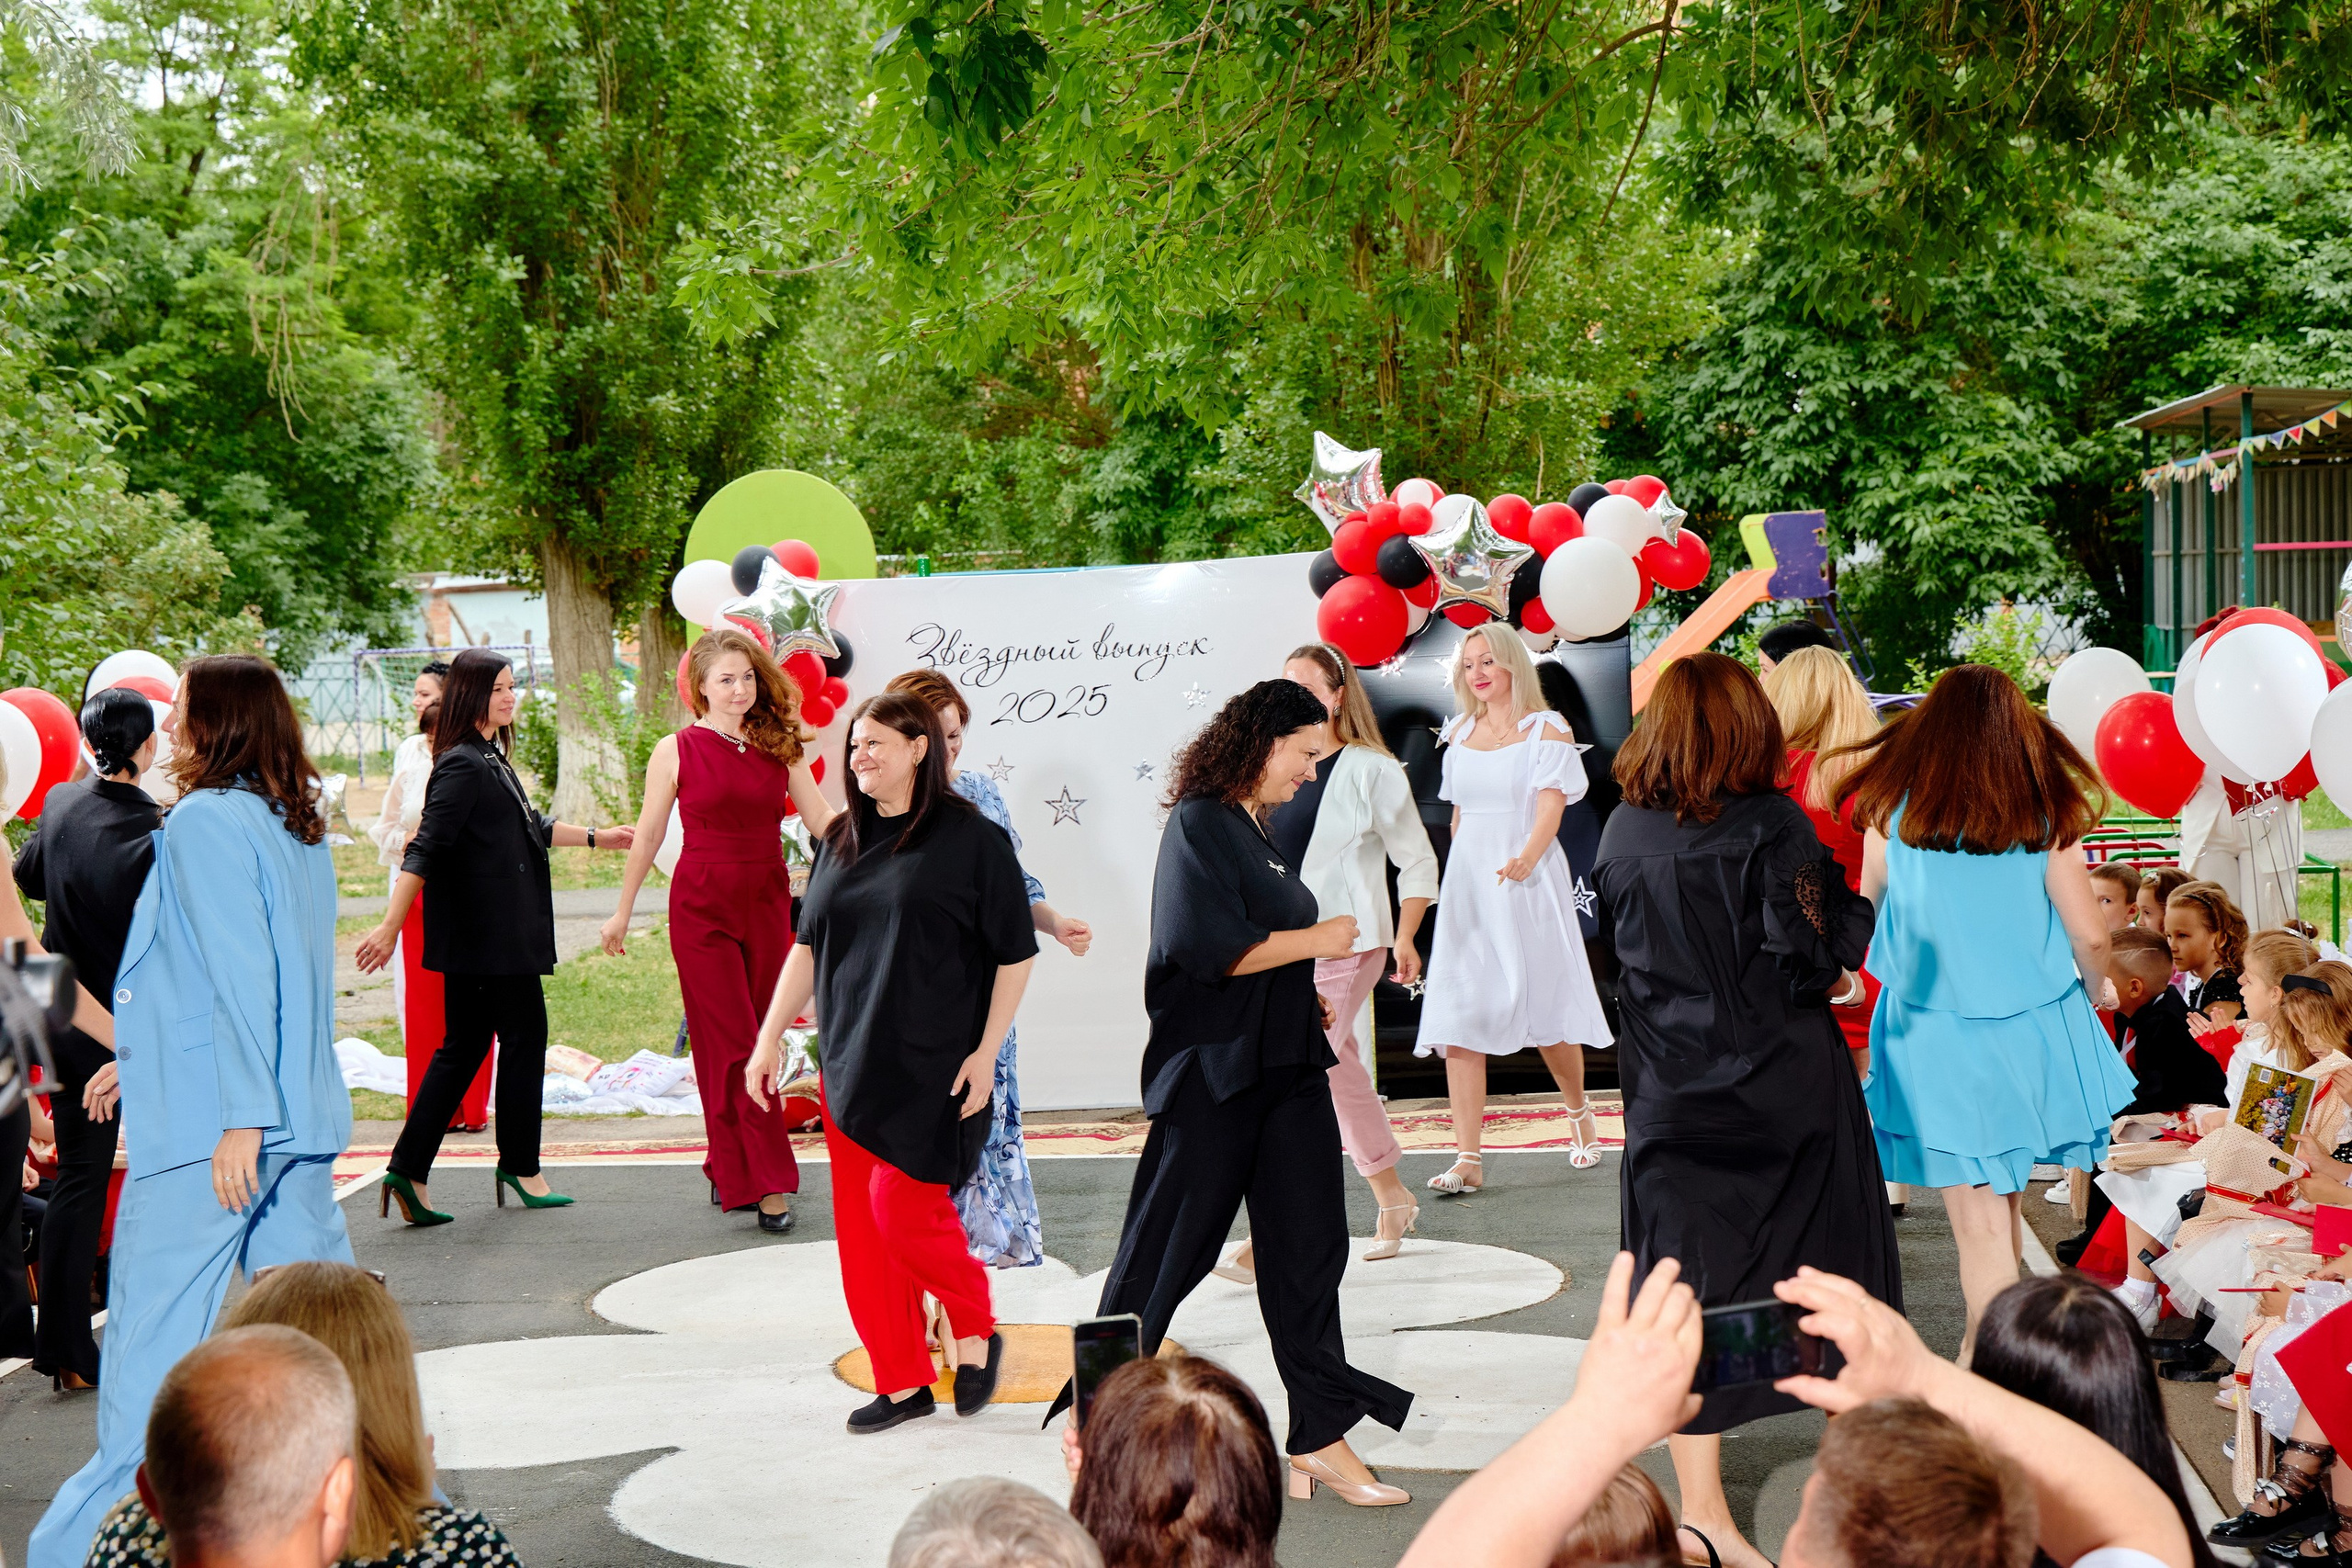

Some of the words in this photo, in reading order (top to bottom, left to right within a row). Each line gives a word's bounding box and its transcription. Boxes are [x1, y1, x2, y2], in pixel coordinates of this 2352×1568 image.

[905, 622, 1082, 687] Звёздный
[1092, 622, 1214, 682] выпуск
[990, 684, 1112, 726] 2025
